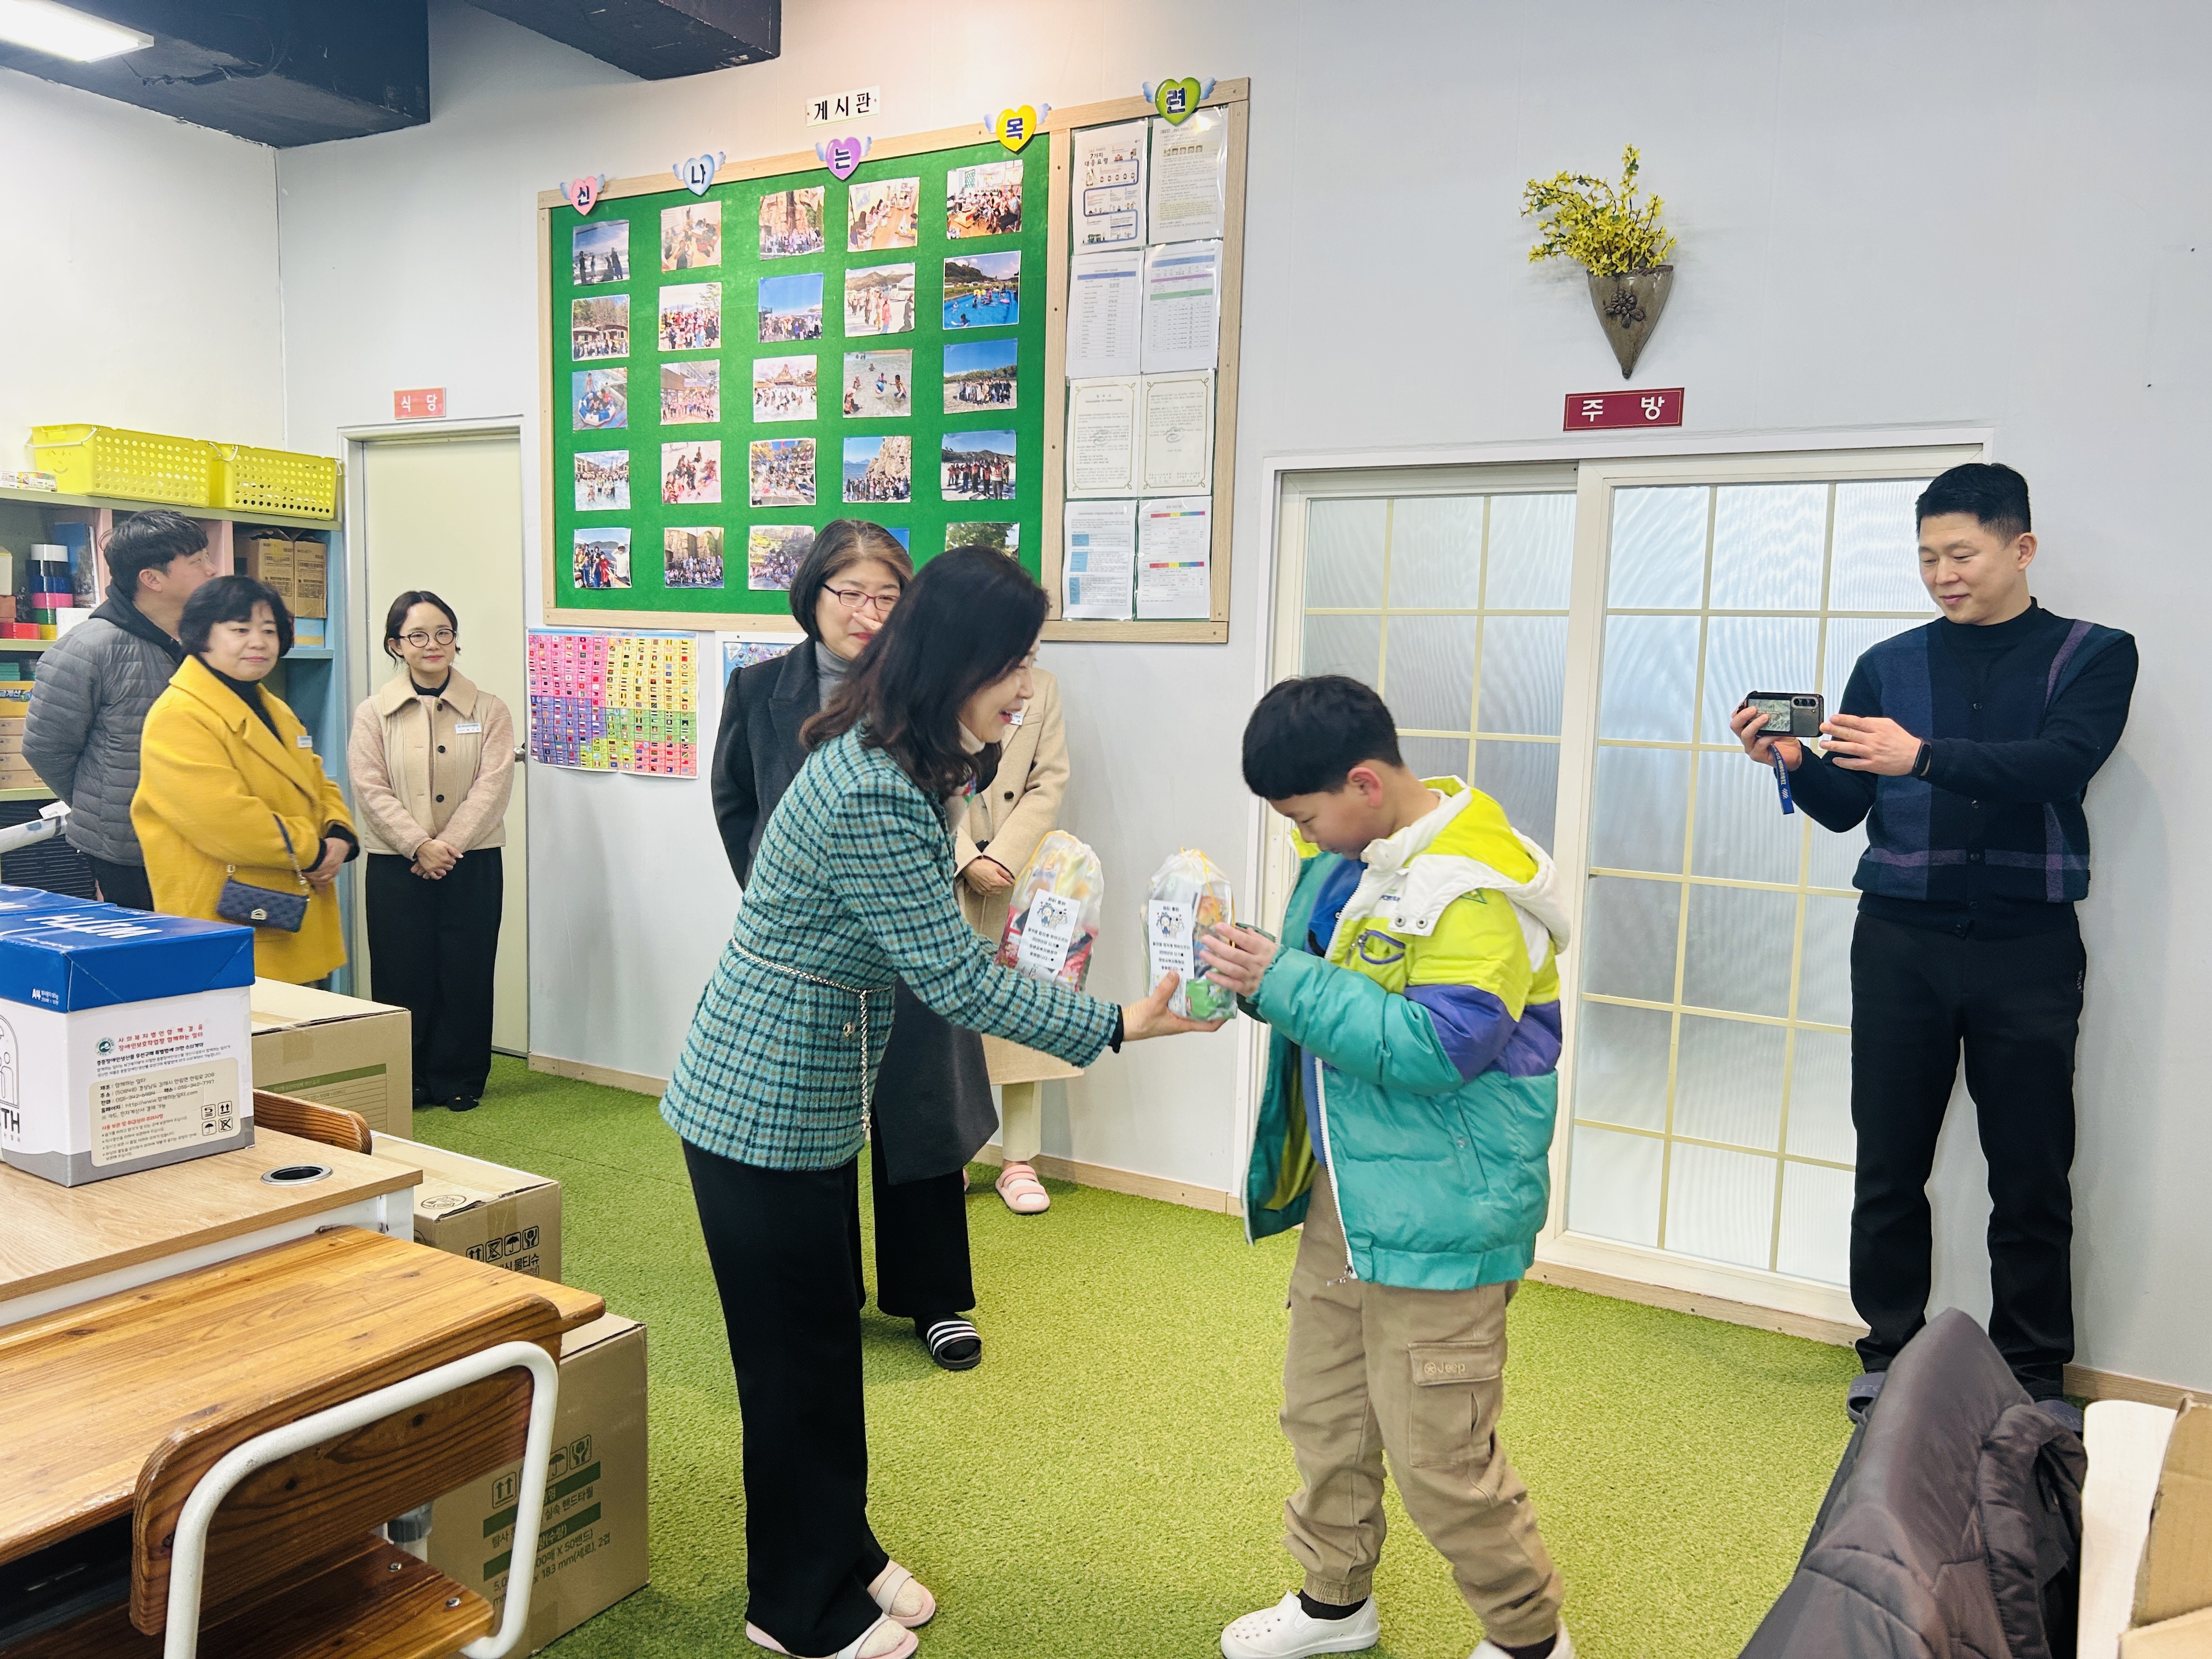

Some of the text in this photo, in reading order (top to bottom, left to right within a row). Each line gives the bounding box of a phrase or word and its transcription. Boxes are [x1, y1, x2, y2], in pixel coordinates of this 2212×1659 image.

[814, 92, 871, 120] 게시판
[32, 988, 41, 1000] A4
[139, 1082, 157, 1091] 경상남도
[0, 1108, 20, 1133] TH
[514, 1253, 540, 1272] 물티슈
[542, 1564, 556, 1579] 183
